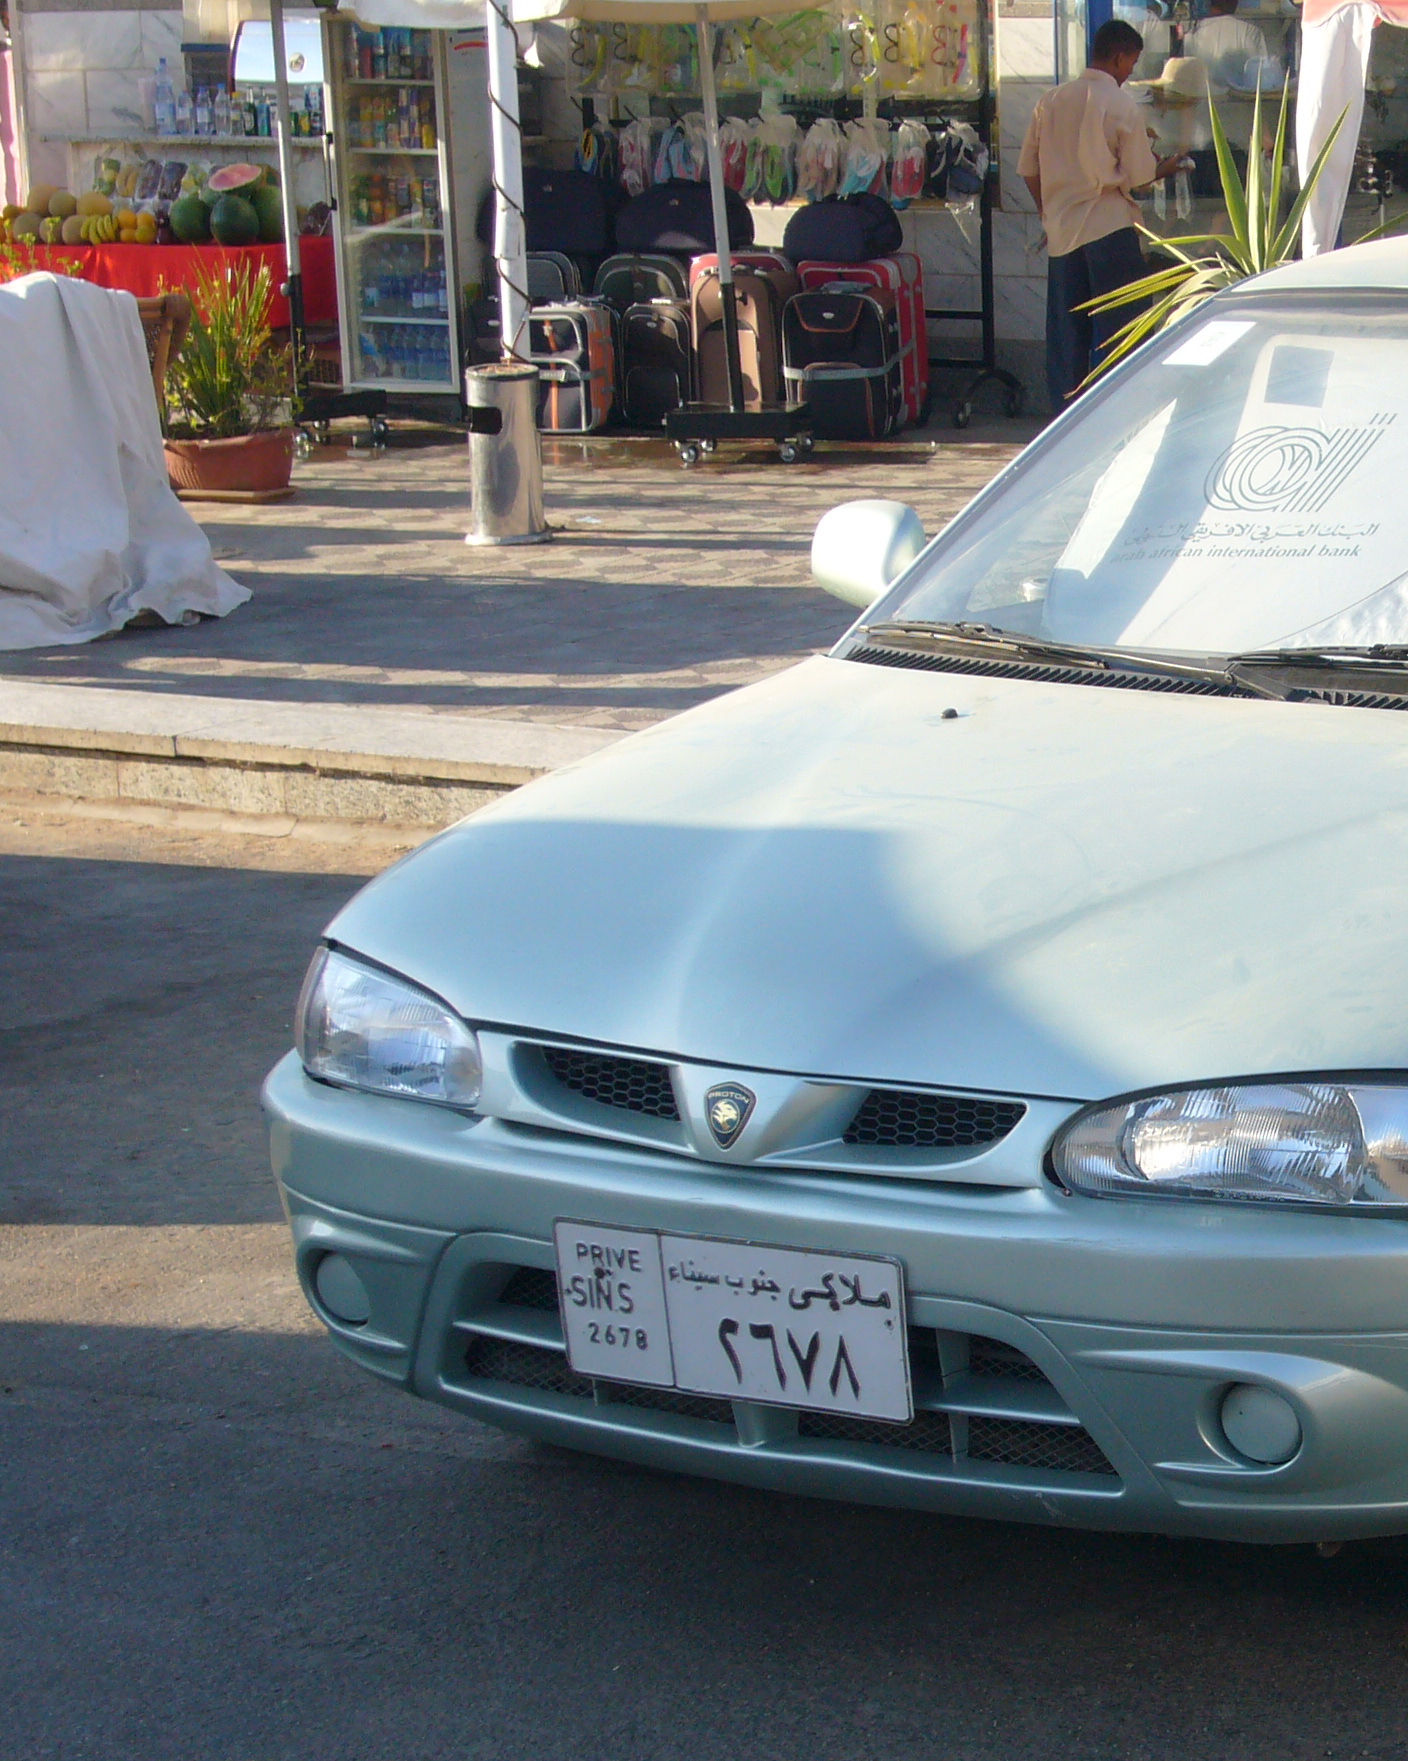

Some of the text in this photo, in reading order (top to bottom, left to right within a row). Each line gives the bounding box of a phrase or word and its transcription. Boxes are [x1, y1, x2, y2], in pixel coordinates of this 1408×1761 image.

[1148, 544, 1203, 558] african
[1207, 544, 1316, 558] international
[1318, 544, 1361, 557] bank
[708, 1091, 750, 1104] PROTON
[576, 1242, 641, 1272] PRIVE
[668, 1260, 720, 1291] سيناء
[725, 1269, 782, 1301] جنوب
[588, 1320, 648, 1351] 2678
[718, 1317, 861, 1402] ٢٦٧٨
